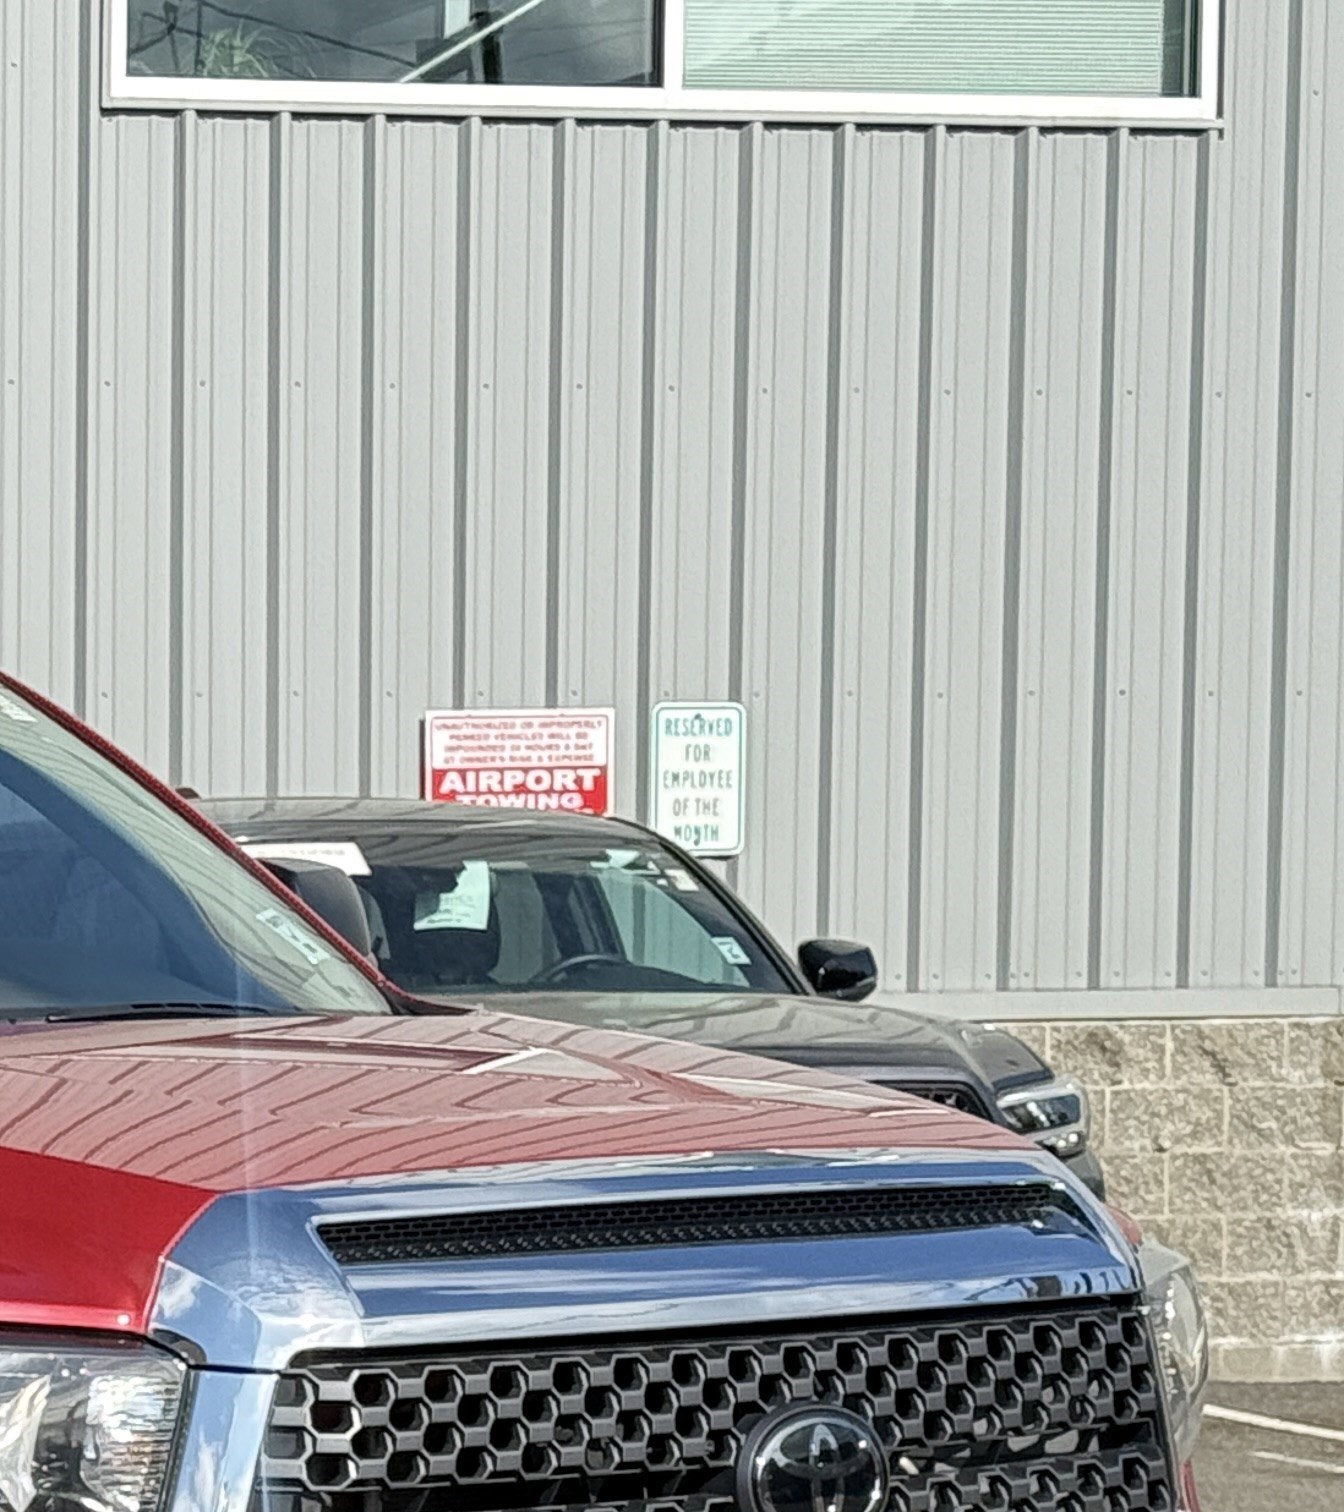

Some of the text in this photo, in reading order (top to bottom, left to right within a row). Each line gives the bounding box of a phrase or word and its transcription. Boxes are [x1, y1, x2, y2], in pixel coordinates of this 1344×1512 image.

[665, 717, 733, 737] RESERVED
[684, 743, 711, 762] FOR
[439, 768, 601, 794] AIRPORT
[662, 769, 733, 789] EMPLOYEE
[455, 792, 584, 811] TOWING
[672, 797, 720, 816] OF THE
[674, 824, 720, 843] MONTH
